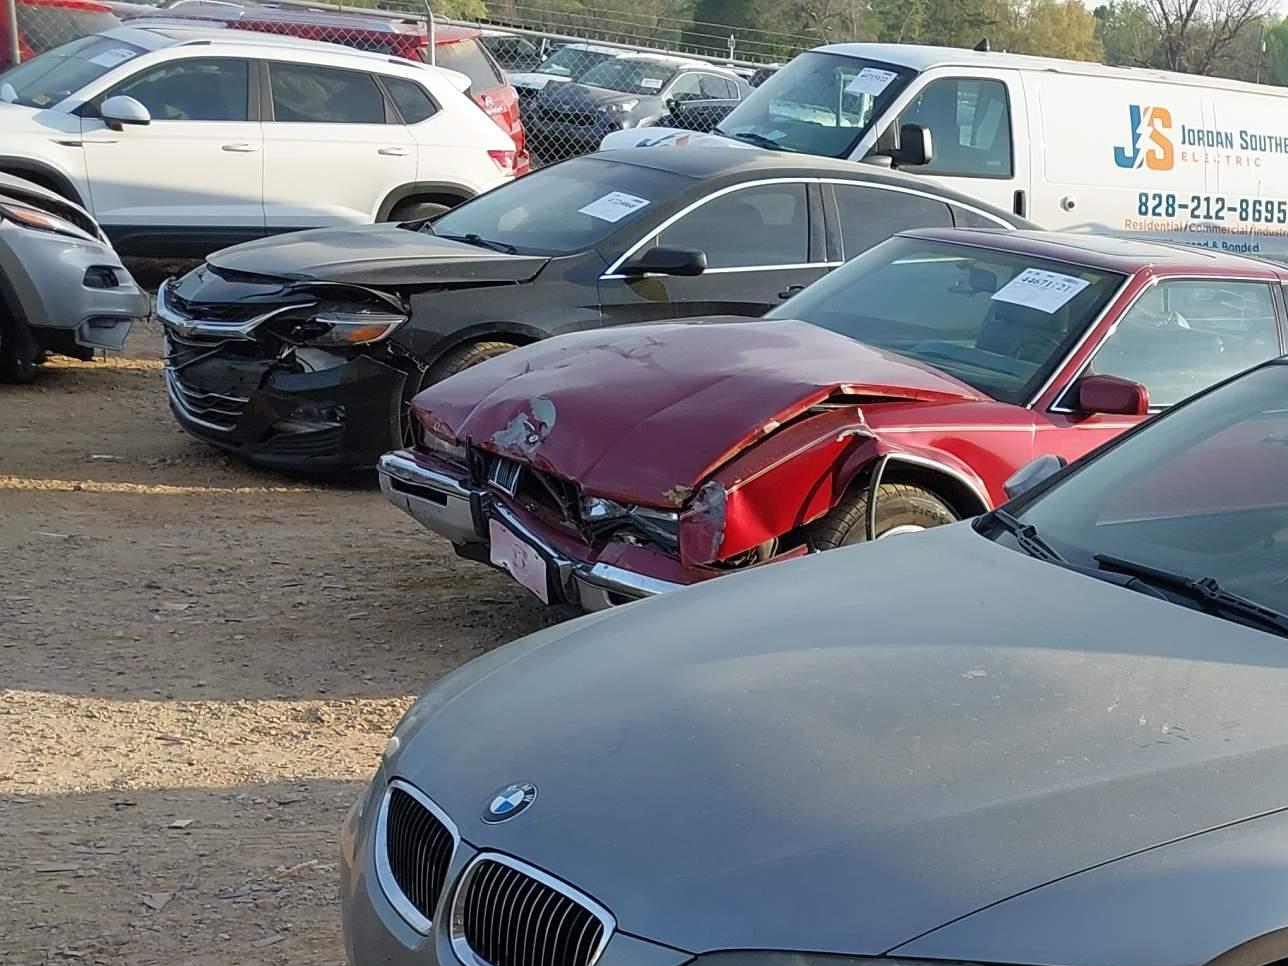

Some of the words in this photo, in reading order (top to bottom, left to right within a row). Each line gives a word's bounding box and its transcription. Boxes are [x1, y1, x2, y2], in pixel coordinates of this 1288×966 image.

[1181, 124, 1234, 149] JORDAN
[1181, 152, 1262, 168] ELECTRIC
[1138, 192, 1287, 224] 828-212-8695
[1222, 242, 1260, 253] Bonded
